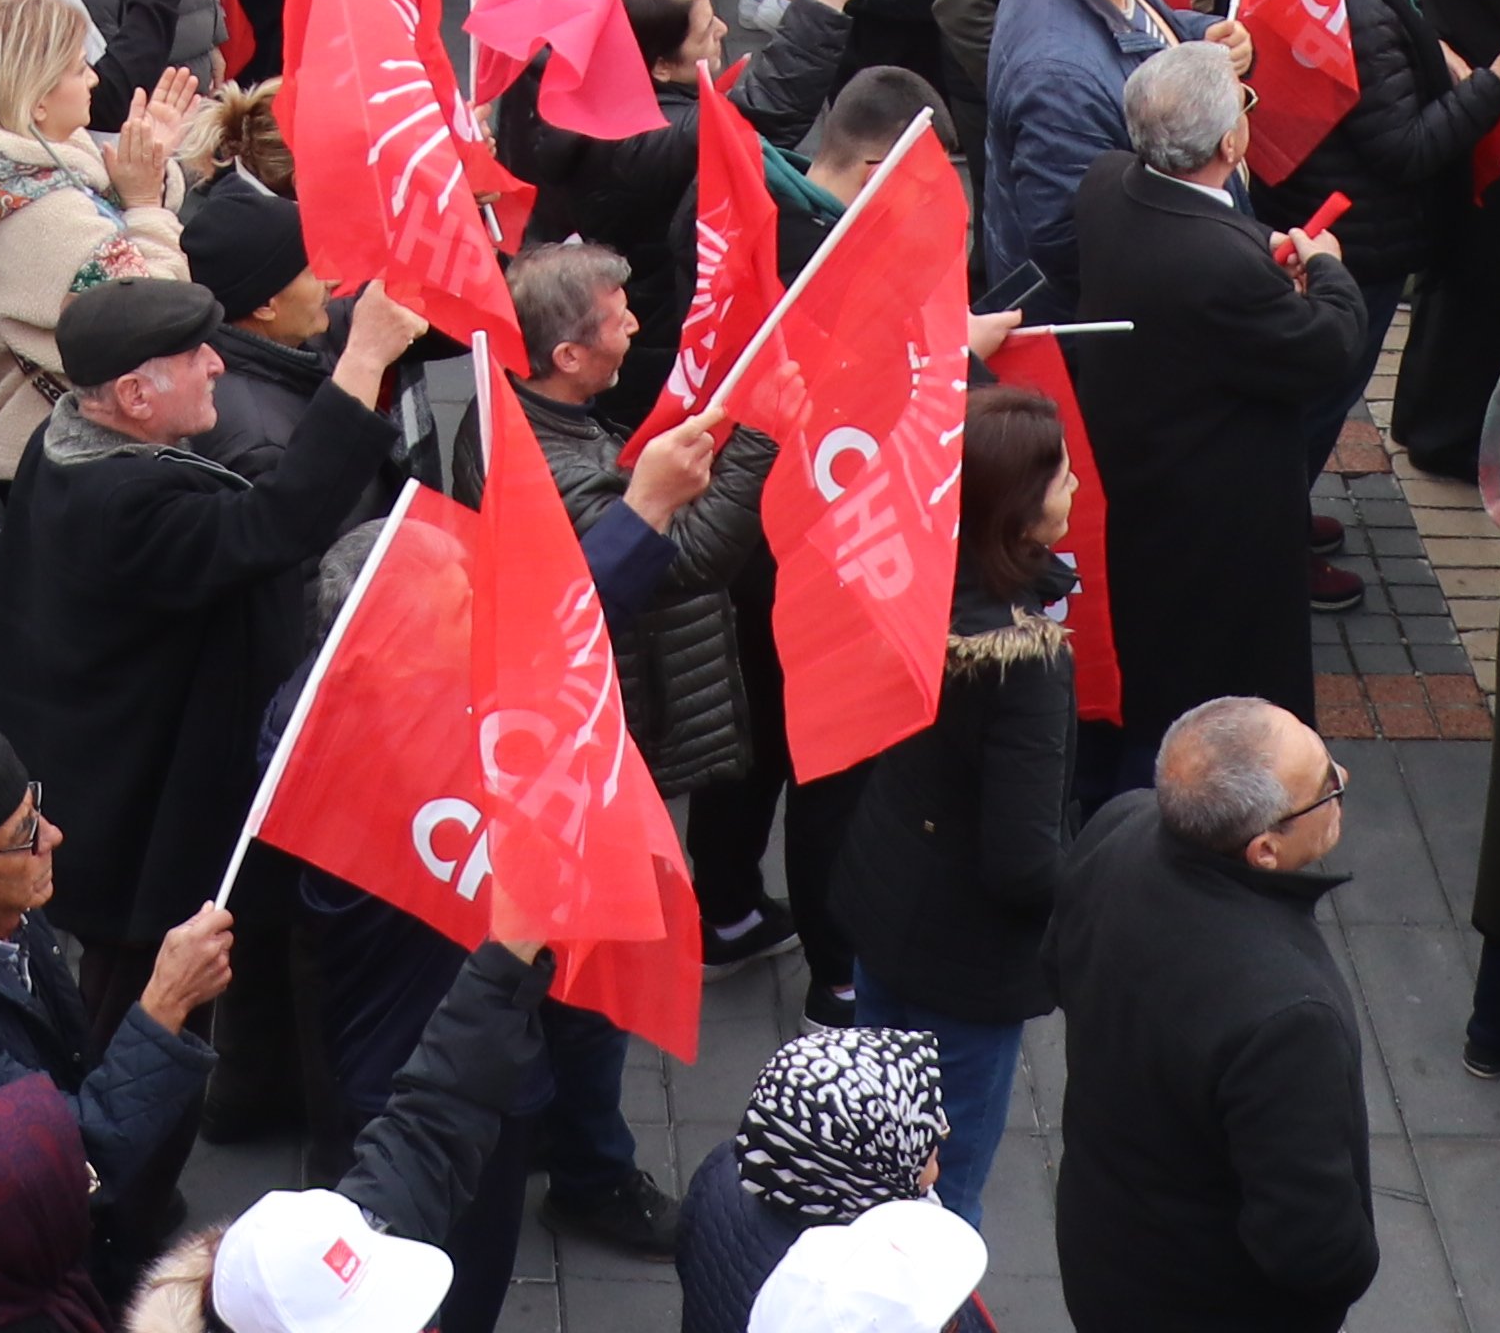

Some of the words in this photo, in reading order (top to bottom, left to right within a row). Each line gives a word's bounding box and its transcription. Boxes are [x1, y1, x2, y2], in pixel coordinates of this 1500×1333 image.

[400, 188, 495, 291] HP
[813, 427, 914, 603] CHP
[411, 798, 492, 900] CH
